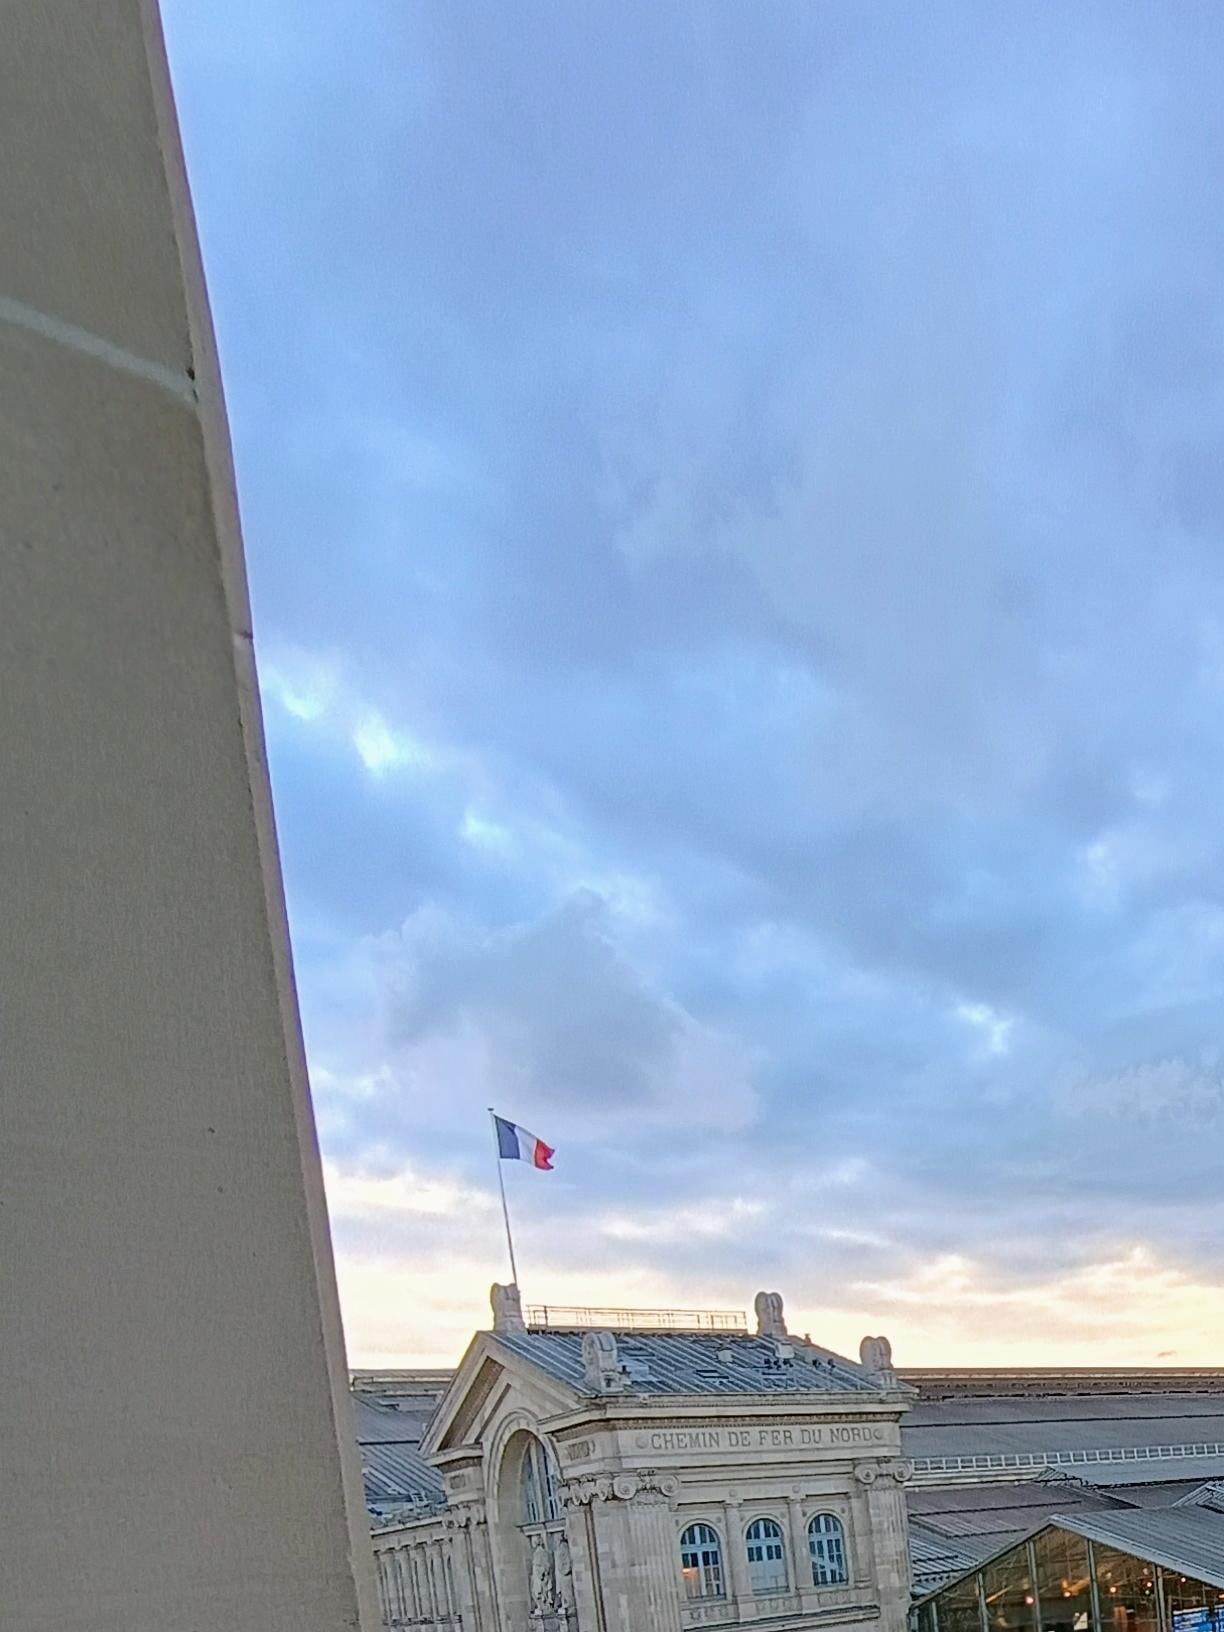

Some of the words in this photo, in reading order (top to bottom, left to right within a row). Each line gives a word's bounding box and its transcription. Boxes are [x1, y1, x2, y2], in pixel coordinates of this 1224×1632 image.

[651, 1431, 720, 1450] CHEMIN
[728, 1431, 751, 1448] DE
[759, 1429, 794, 1446] FER
[800, 1428, 822, 1445] DU
[830, 1427, 872, 1444] NORD
